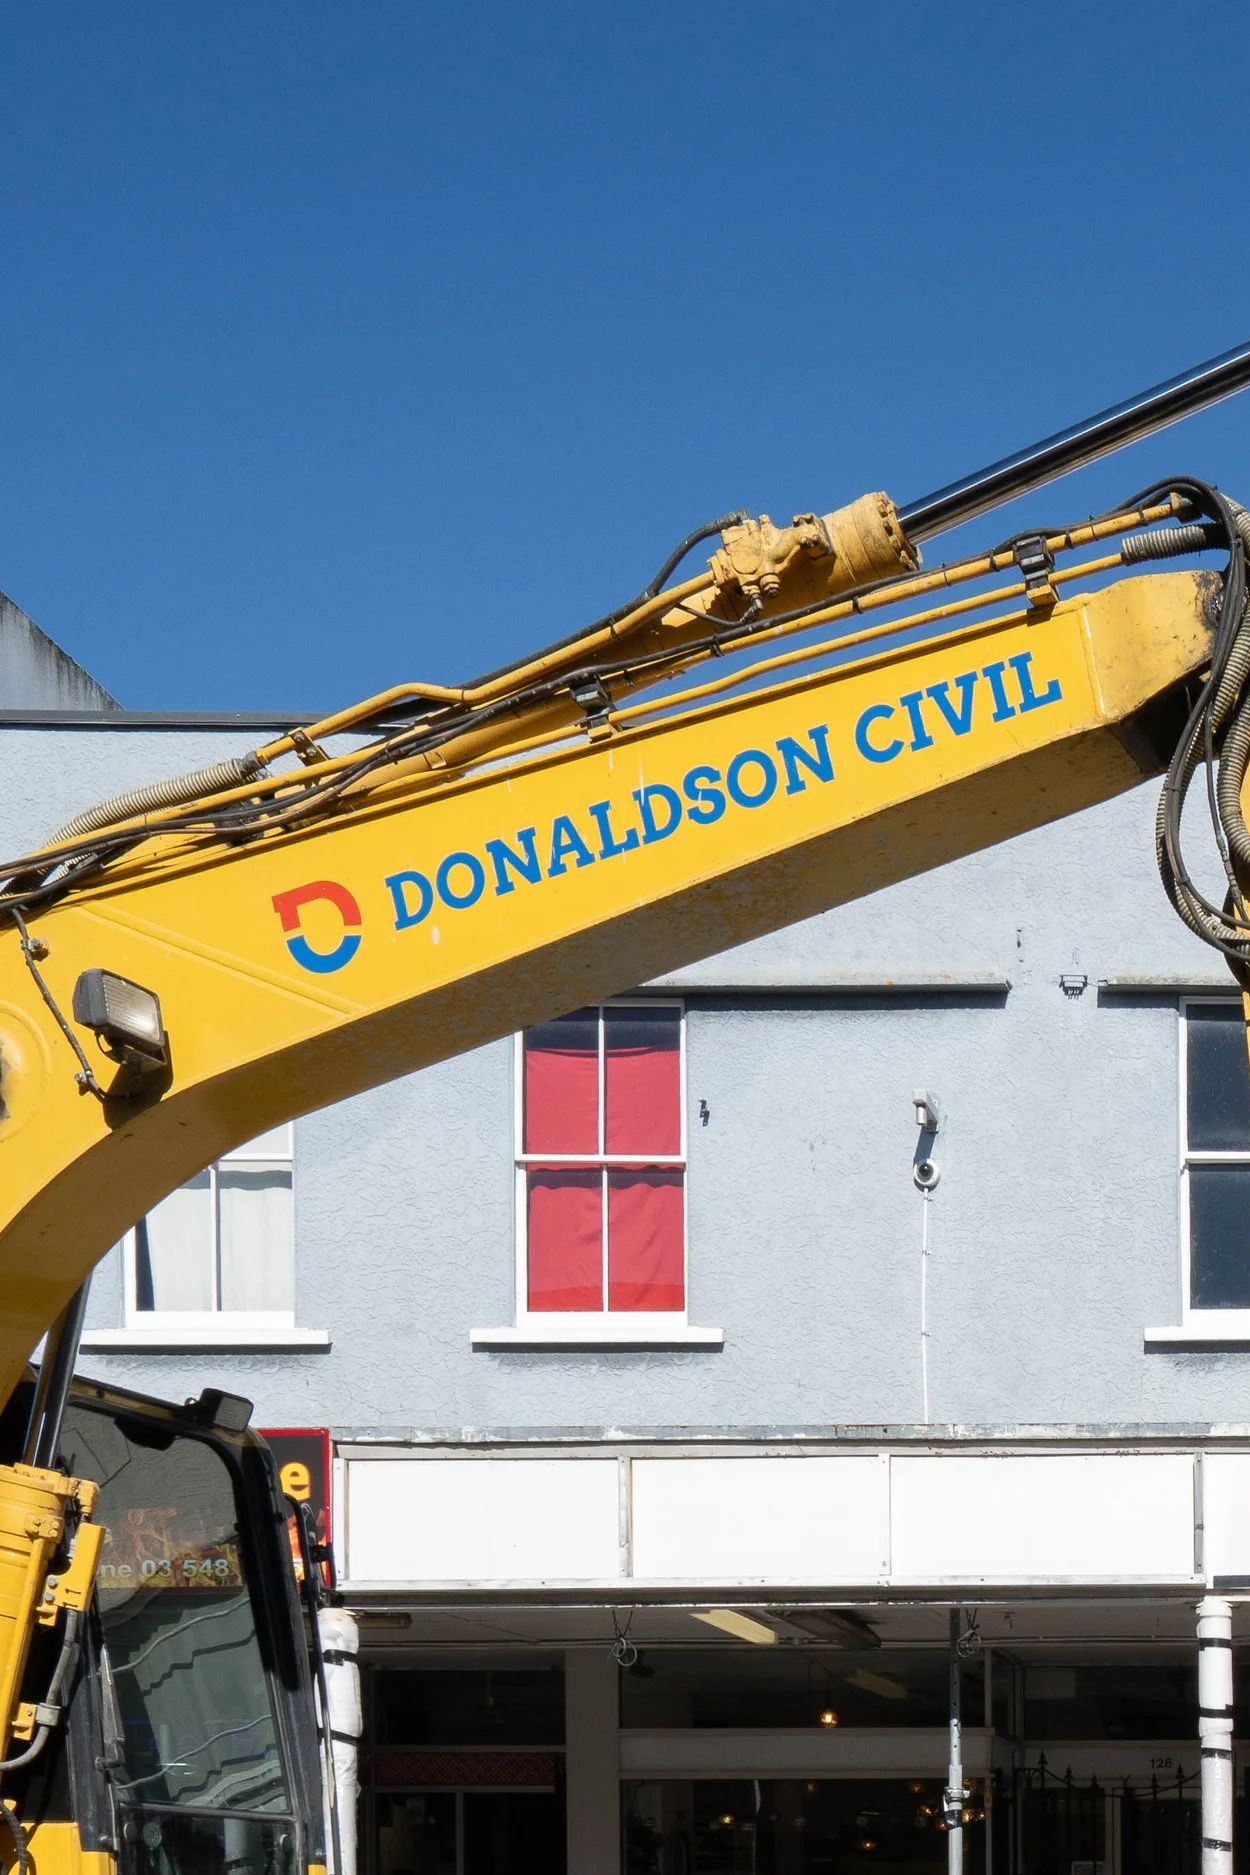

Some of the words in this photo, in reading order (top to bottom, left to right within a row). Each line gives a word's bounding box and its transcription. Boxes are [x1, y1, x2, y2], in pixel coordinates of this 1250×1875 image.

[384, 723, 835, 931] DONALDSON
[854, 651, 1063, 764] CIVIL
[141, 1559, 172, 1578] 03
[182, 1558, 230, 1578] 548
